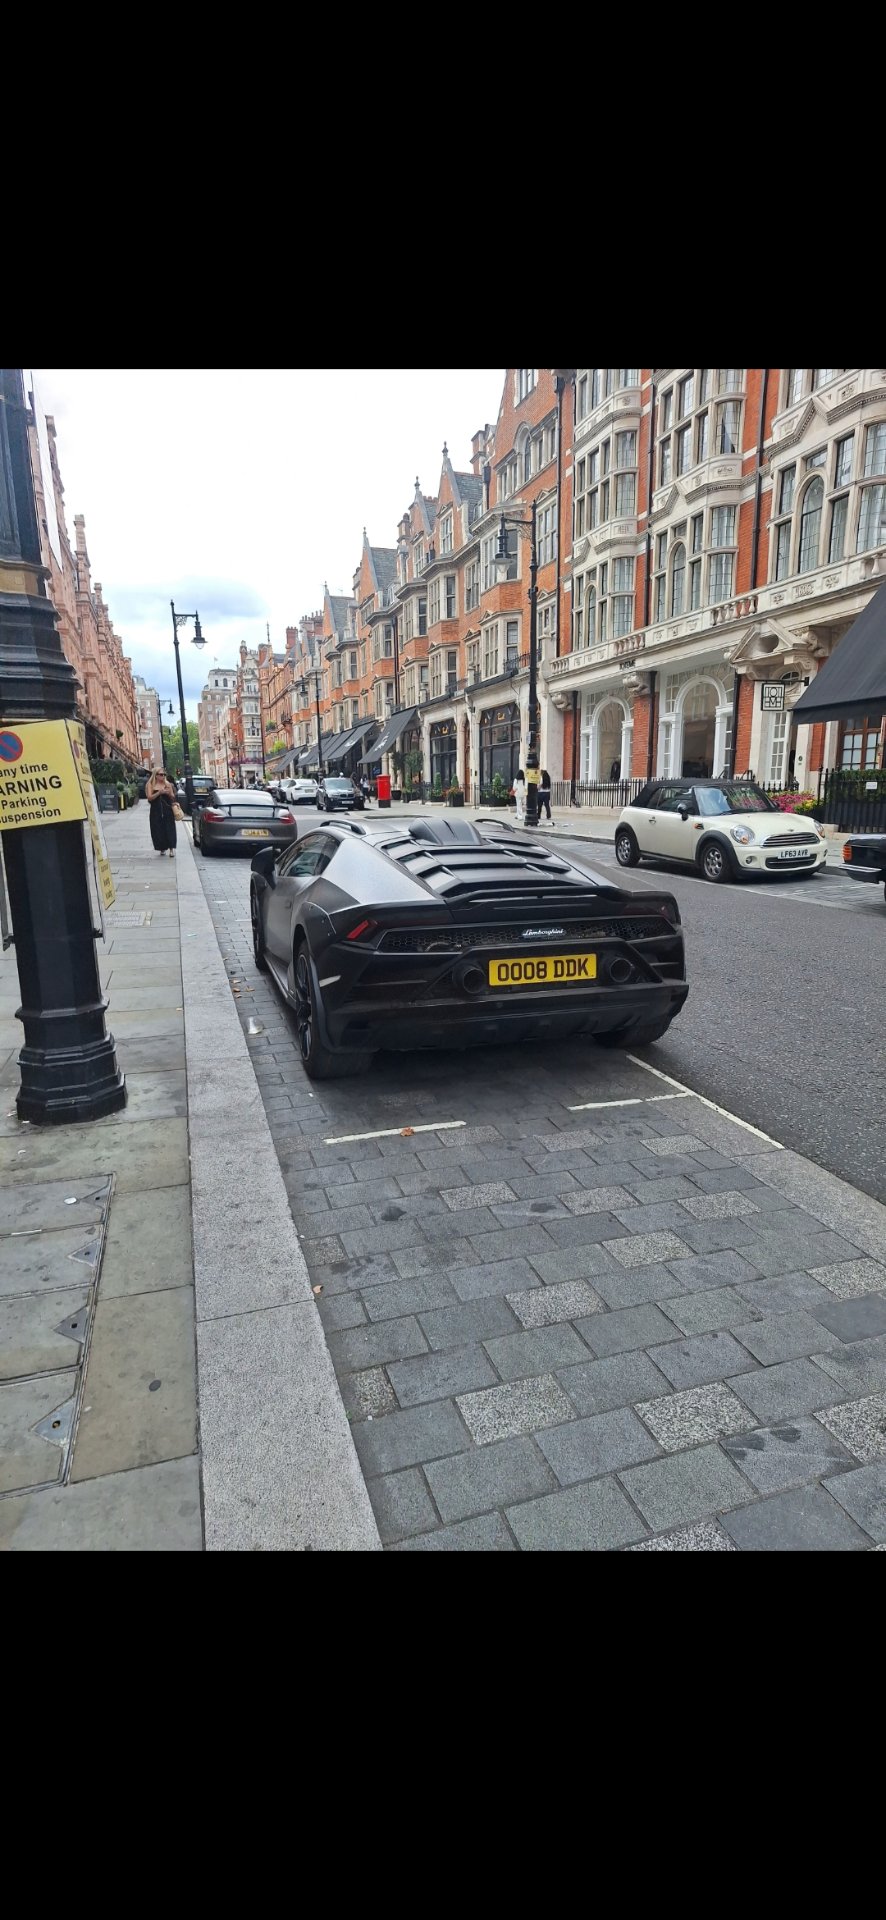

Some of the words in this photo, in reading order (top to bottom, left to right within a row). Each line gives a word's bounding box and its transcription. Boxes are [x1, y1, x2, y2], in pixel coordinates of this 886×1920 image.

[20, 763, 48, 774] time
[1, 797, 47, 810] Parking
[0, 808, 61, 824] uspension
[553, 958, 589, 977] DDK
